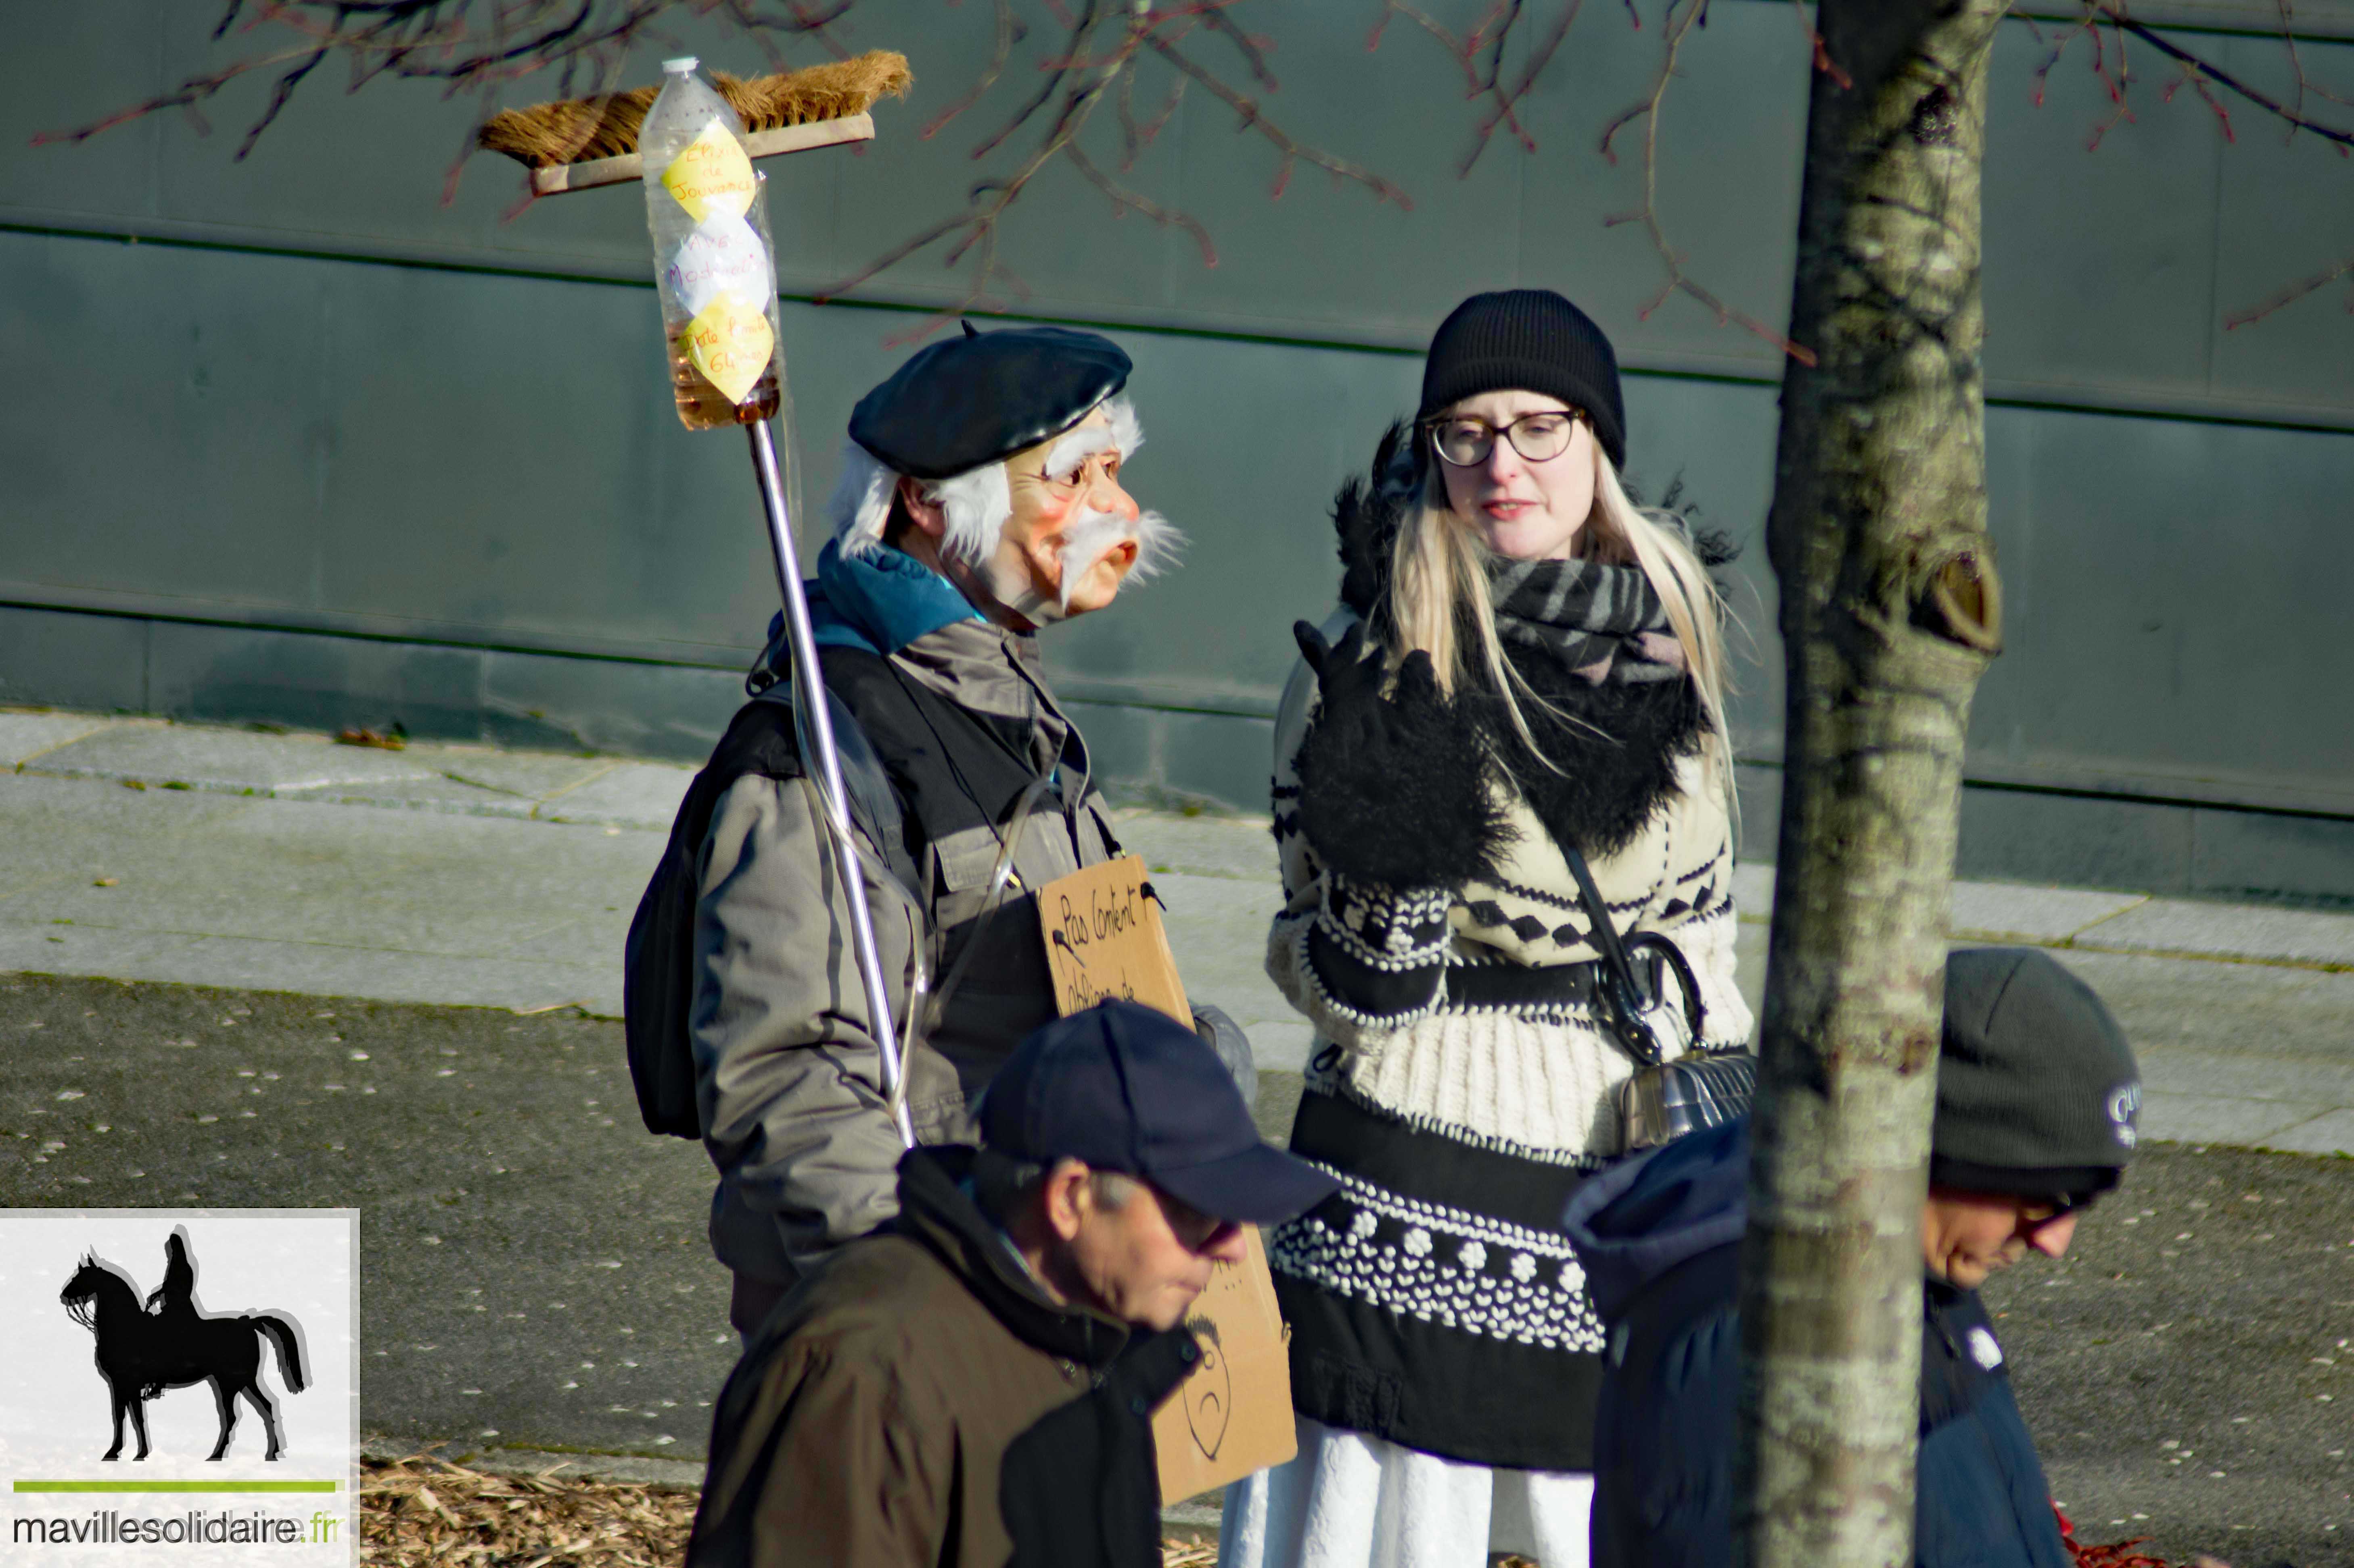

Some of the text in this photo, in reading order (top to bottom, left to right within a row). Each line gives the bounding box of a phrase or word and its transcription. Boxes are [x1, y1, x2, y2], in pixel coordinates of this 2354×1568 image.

[703, 161, 723, 177] de
[710, 352, 735, 373] 64
[1061, 894, 1088, 945] Pas
[1121, 966, 1135, 1002] de
